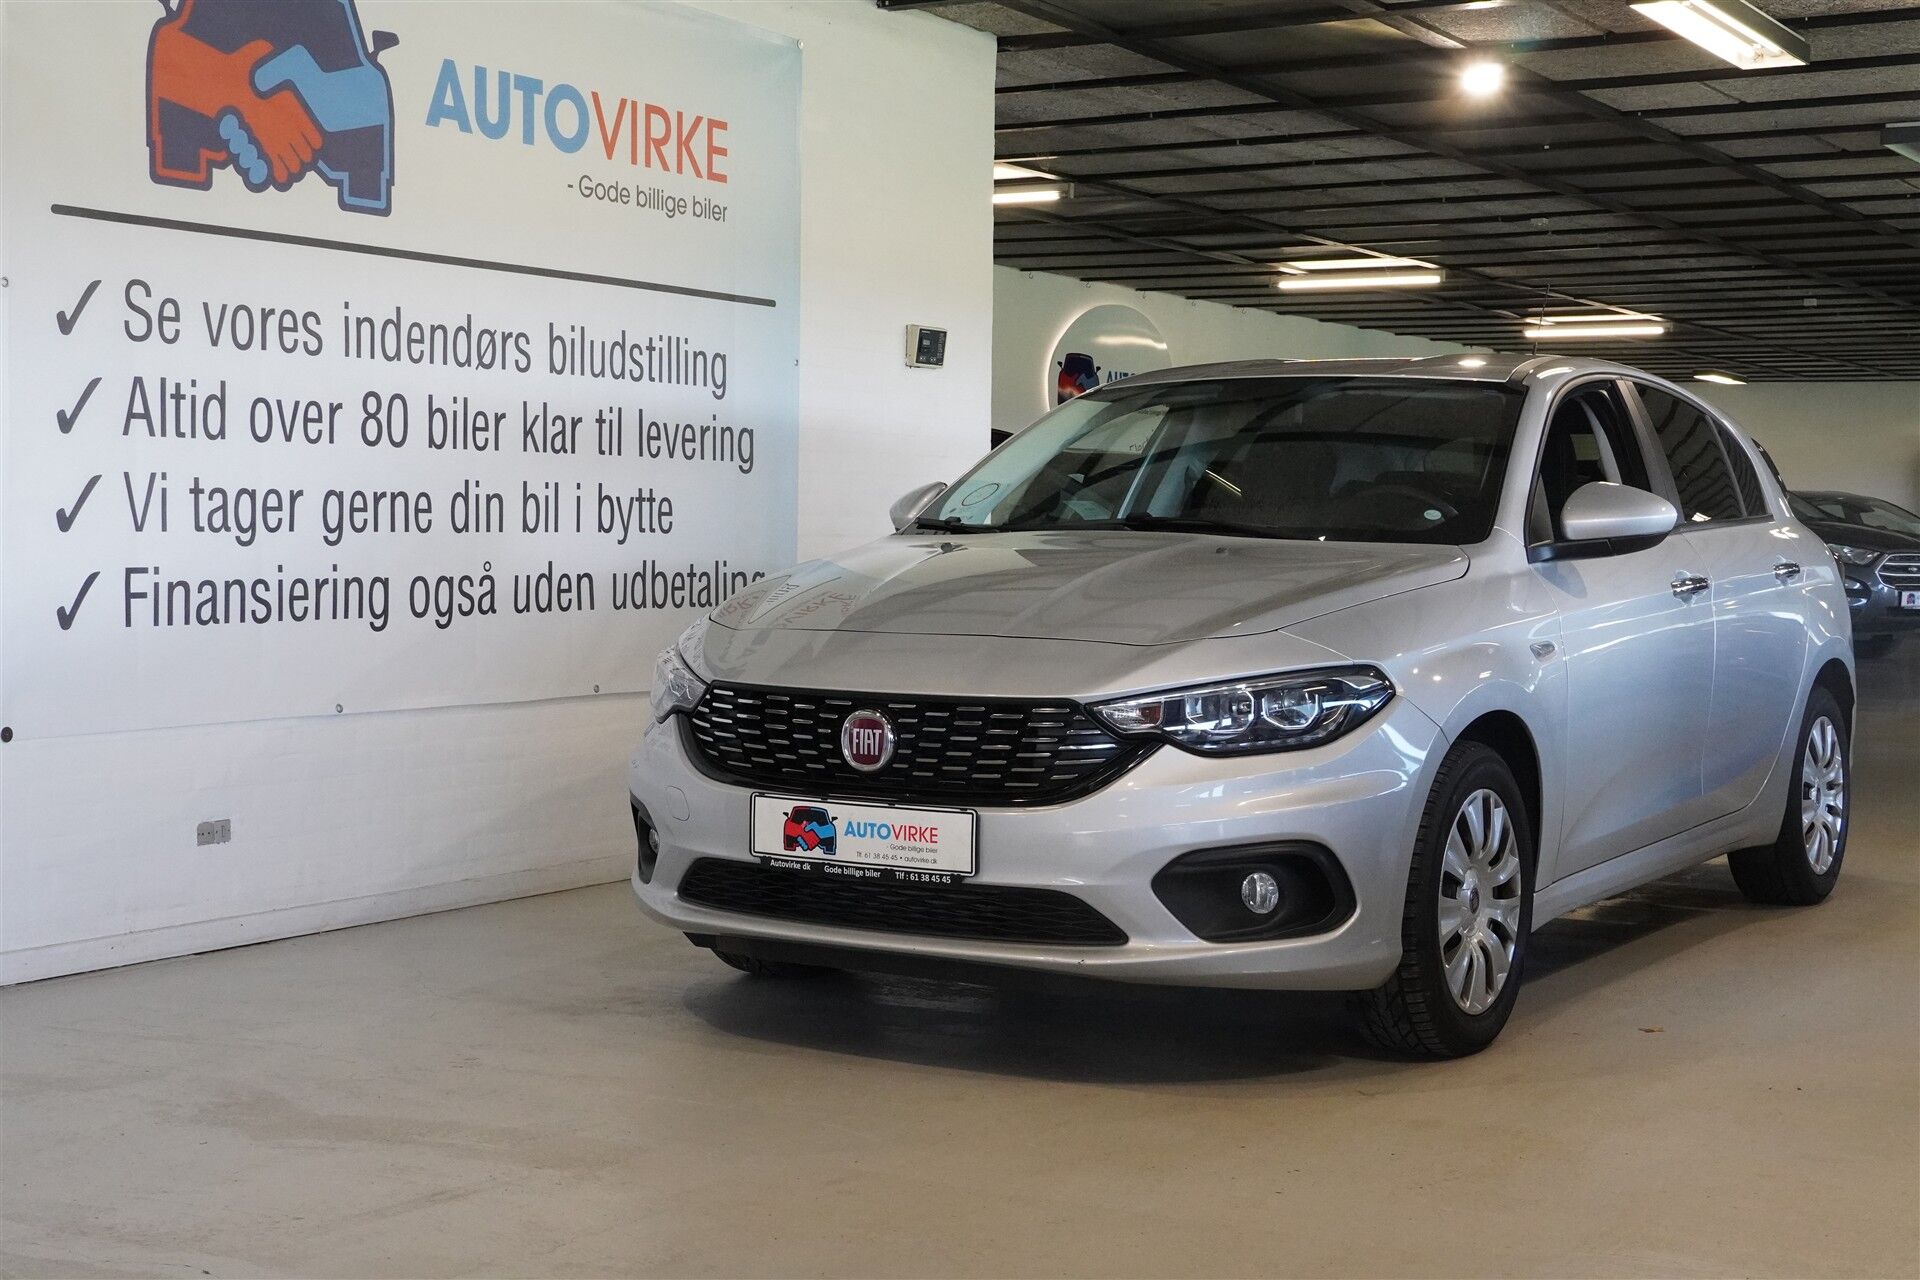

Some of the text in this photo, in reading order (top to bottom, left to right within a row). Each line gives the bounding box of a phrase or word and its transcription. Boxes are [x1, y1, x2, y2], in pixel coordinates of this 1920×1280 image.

[425, 58, 728, 184] AUTOVIRKE
[578, 174, 631, 205] Gode
[636, 184, 688, 219] billige
[692, 195, 728, 223] biler
[124, 279, 727, 401] Se vores indendørs biludstilling
[122, 375, 755, 475] Altid over 80 biler klar til levering
[123, 471, 674, 548] Vi tager gerne din bil i bytte
[124, 563, 391, 633] Finansiering
[408, 560, 498, 630] også
[513, 560, 596, 614] uden
[612, 559, 766, 611] udbetalin
[852, 728, 882, 756] FIAT
[843, 820, 939, 844] AUTOVIRKE
[770, 859, 801, 870] Autovirke
[824, 865, 881, 878] Gode billige biler
[895, 871, 905, 880] Tlf
[910, 873, 919, 881] 61
[920, 874, 930, 882] 38
[931, 875, 940, 883] 45
[941, 876, 951, 884] 45
